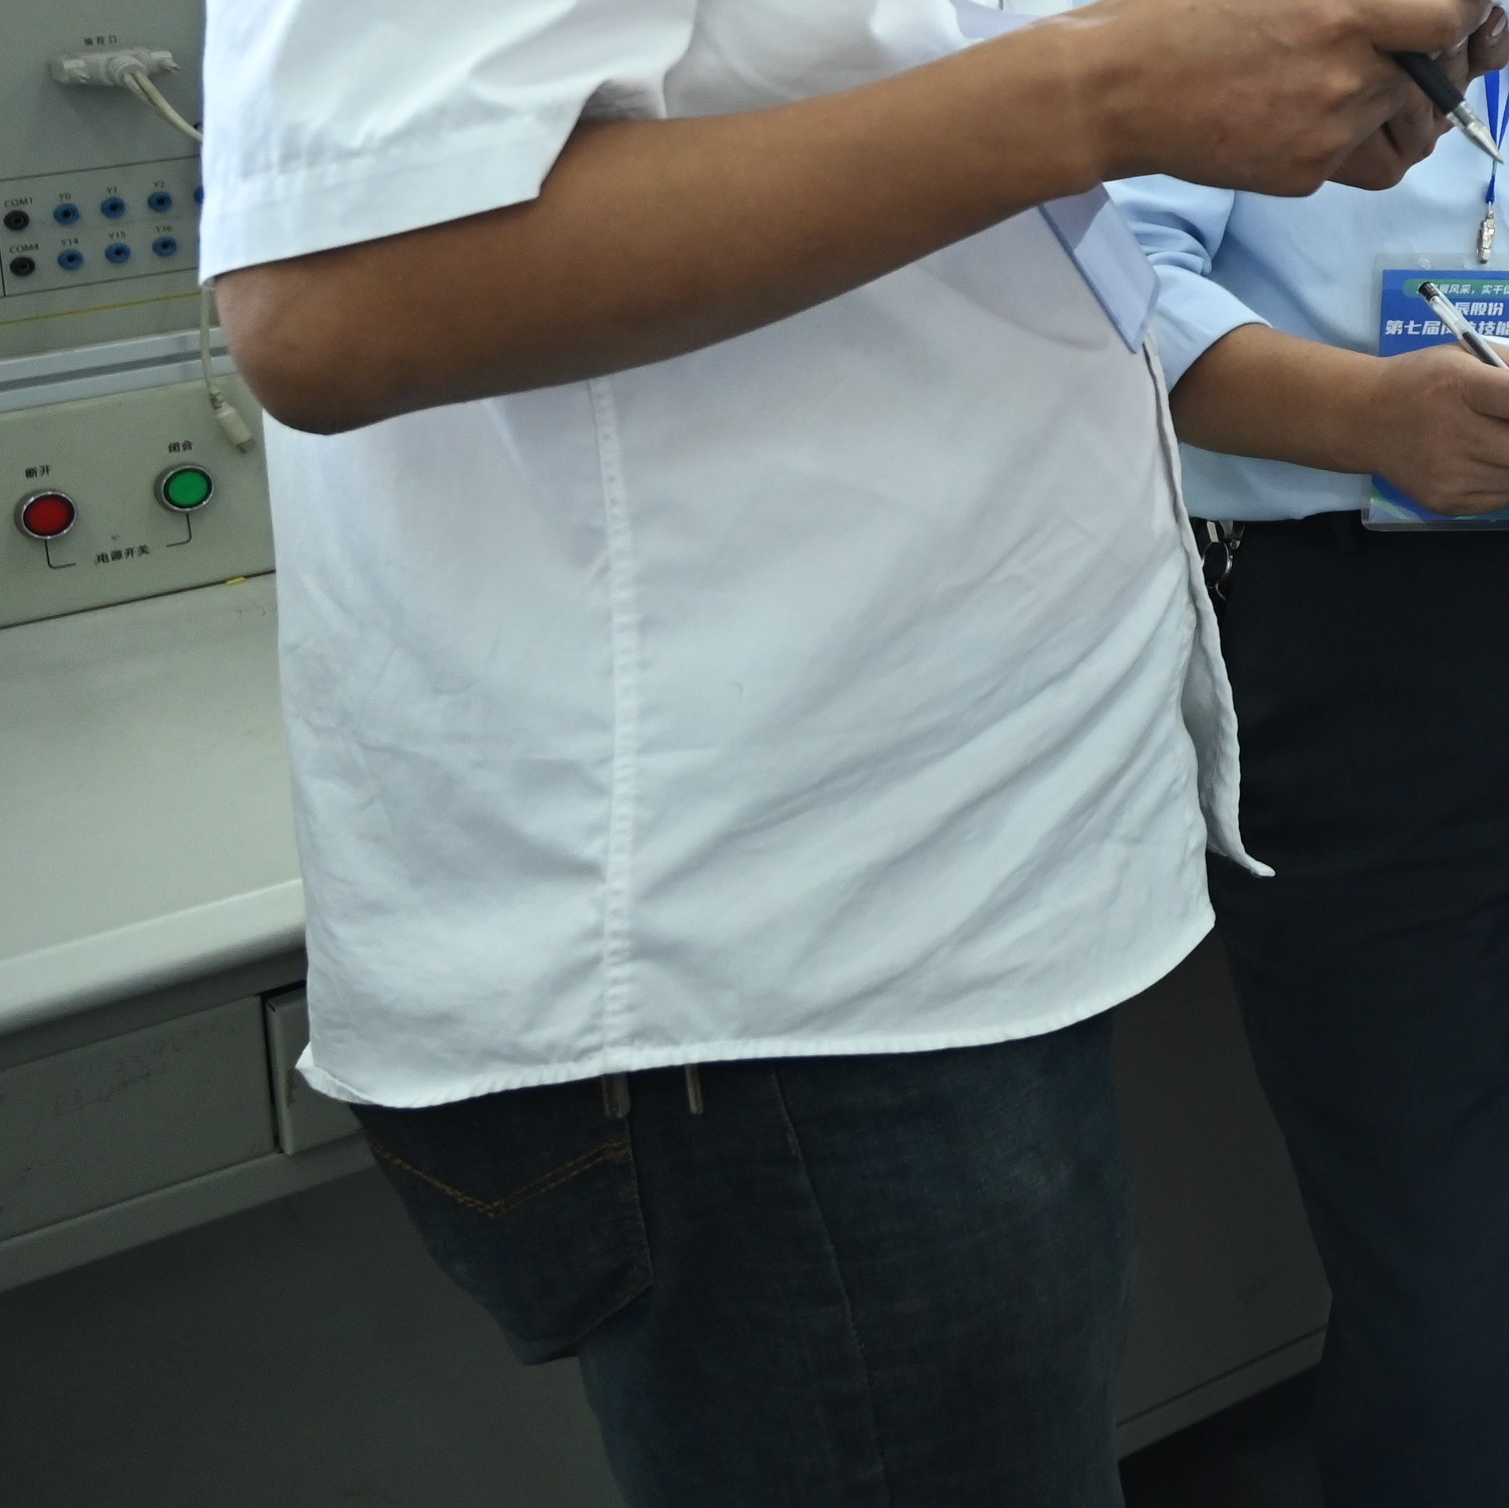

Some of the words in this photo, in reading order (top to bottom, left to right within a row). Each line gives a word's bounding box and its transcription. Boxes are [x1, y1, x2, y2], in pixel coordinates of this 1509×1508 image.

[1453, 301, 1505, 317] 辰股份
[168, 439, 193, 454] 闭合
[24, 464, 51, 479] 断开
[95, 544, 150, 565] 电源开关
